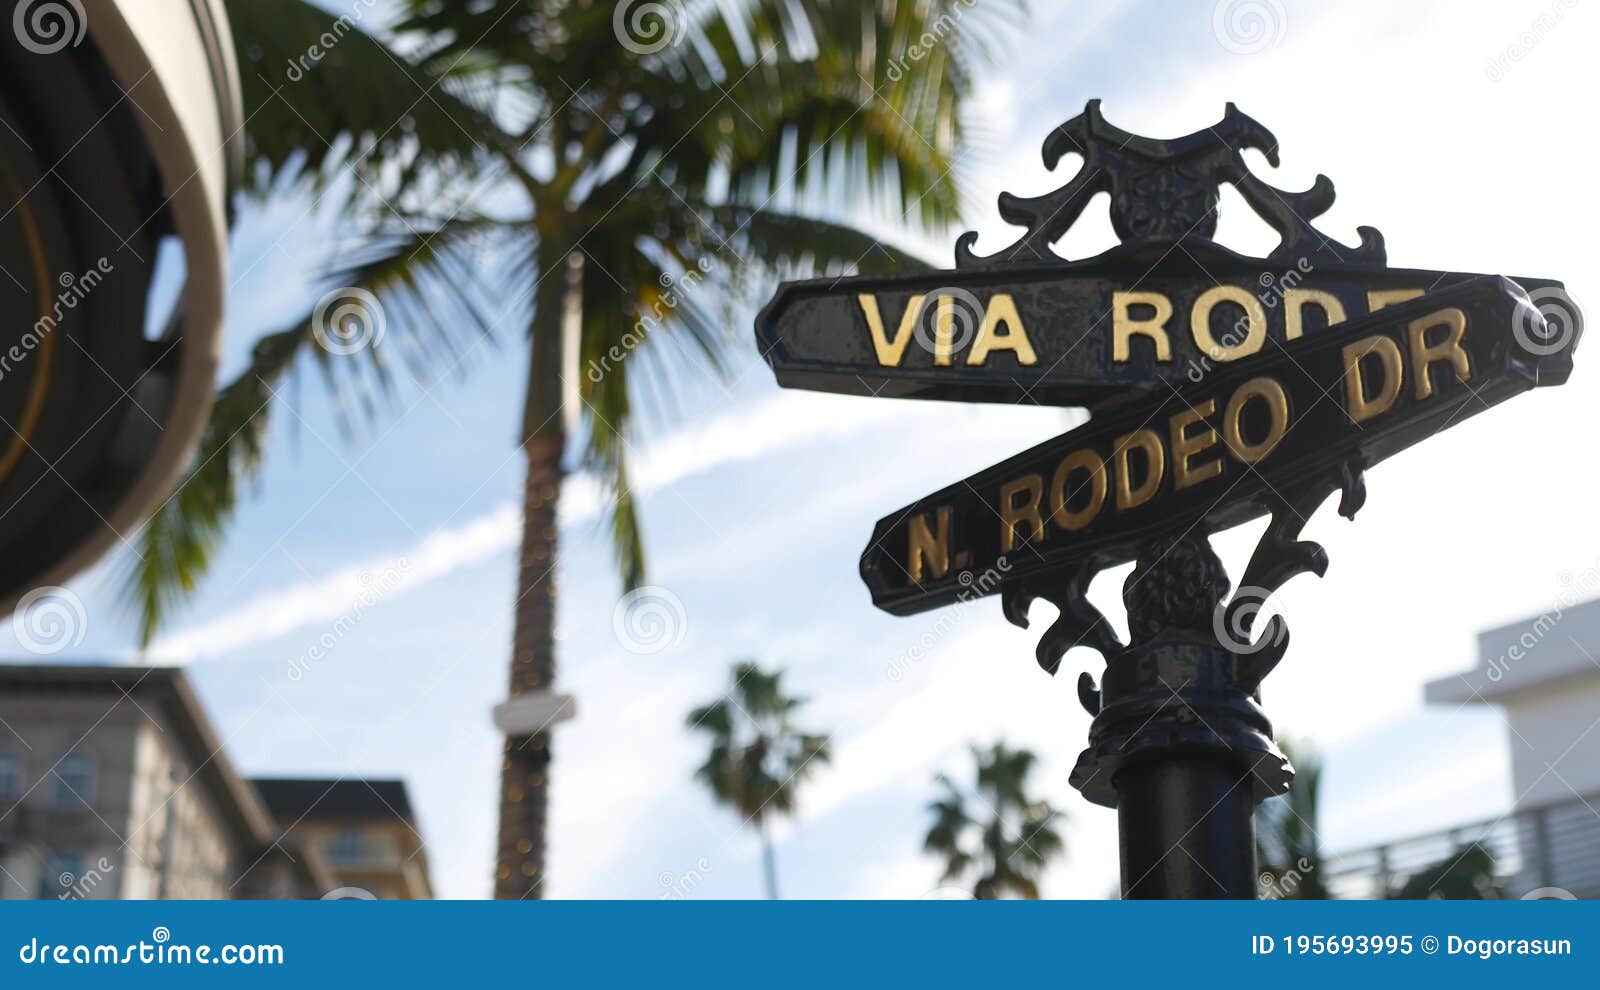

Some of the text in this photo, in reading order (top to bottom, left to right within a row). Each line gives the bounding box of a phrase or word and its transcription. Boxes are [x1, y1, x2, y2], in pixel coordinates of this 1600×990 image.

[858, 285, 1426, 367] VIA ROD
[907, 307, 1471, 585] N. RODEO DR
